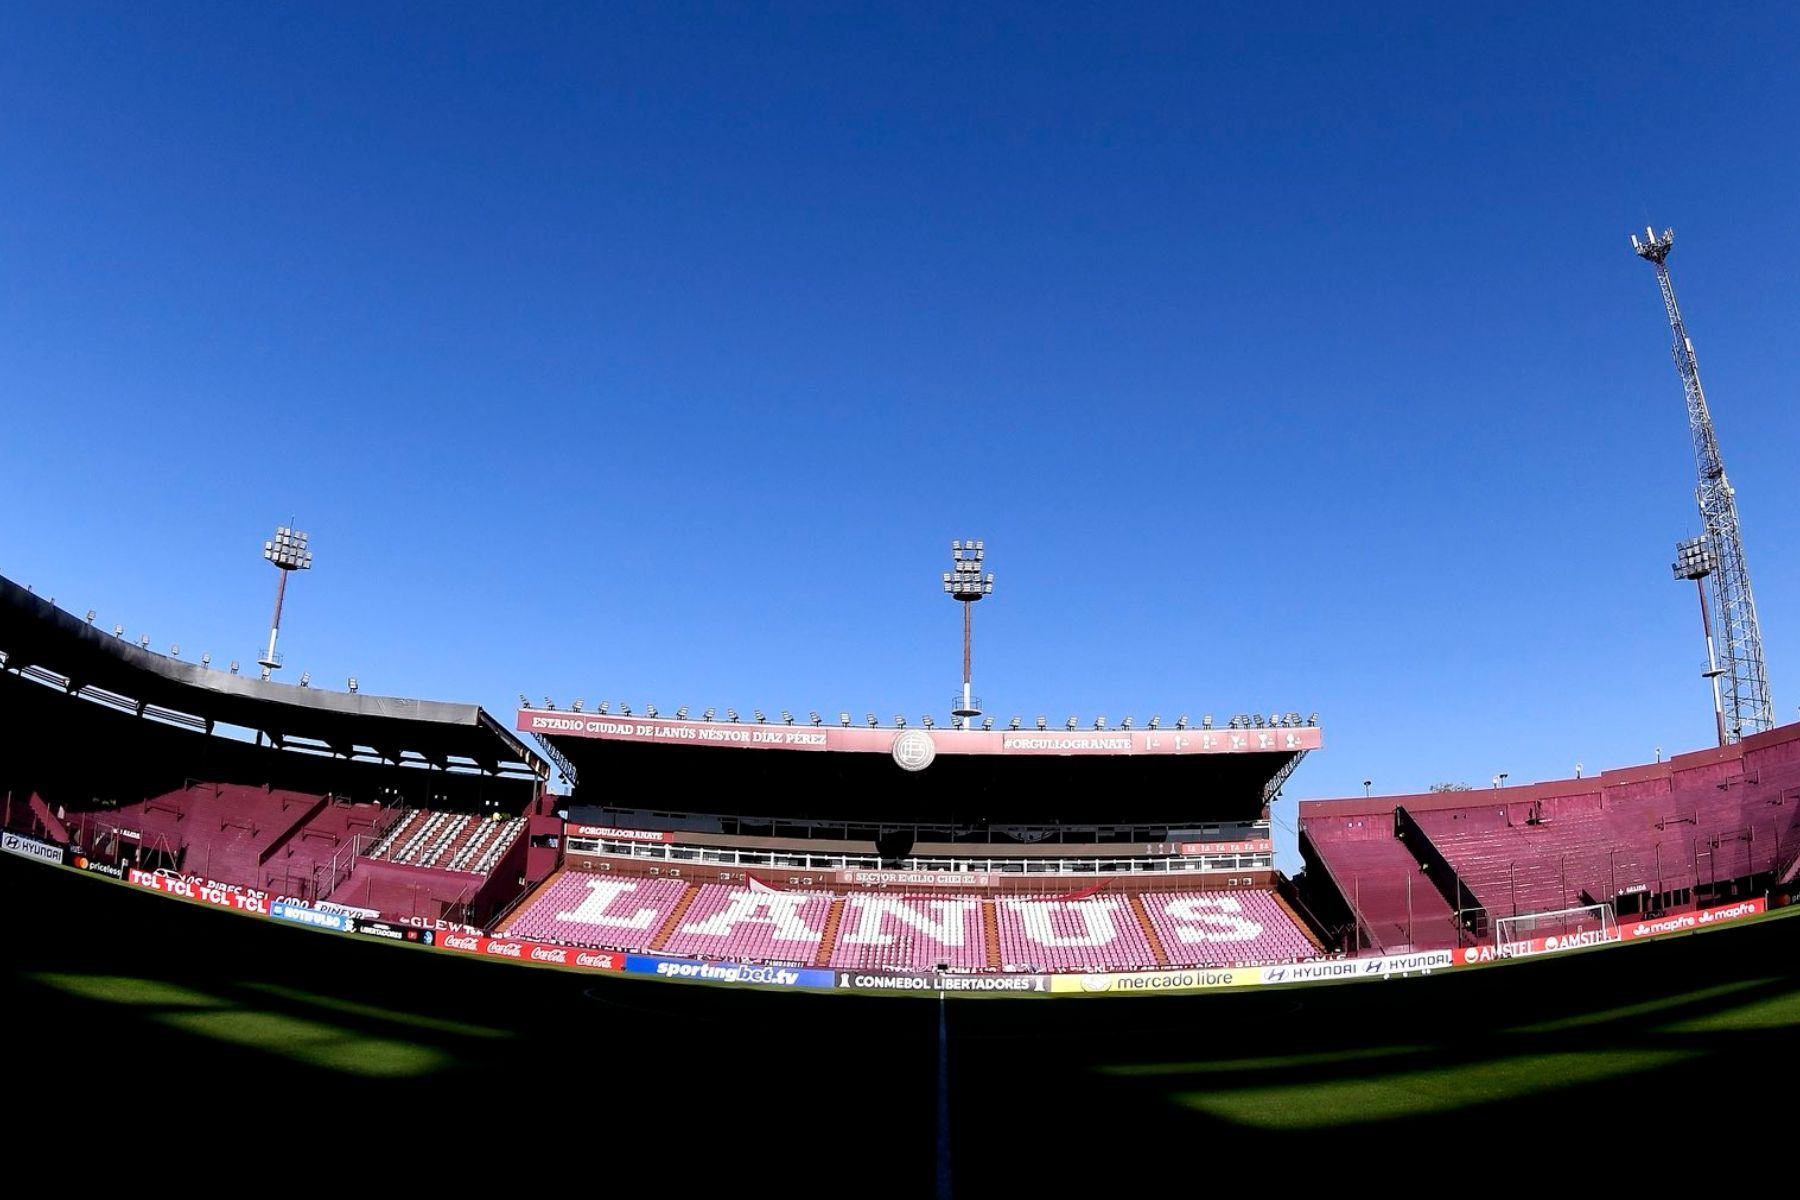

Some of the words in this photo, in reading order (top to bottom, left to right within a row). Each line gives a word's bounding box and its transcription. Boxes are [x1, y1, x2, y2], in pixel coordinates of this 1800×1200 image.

[532, 717, 583, 731] ESTADIO
[586, 721, 633, 735] CIUDAD
[636, 725, 654, 736] DE
[655, 725, 696, 739] LANÚS
[698, 727, 750, 742] NÉSTOR
[752, 730, 783, 743] DÍAZ
[786, 731, 827, 745] PÉREZ
[1004, 738, 1131, 749] #ORGULLOGRANATE
[578, 826, 663, 840] #ORGULLOGRANATE
[22, 842, 61, 861] HYUNDAI
[89, 862, 121, 876] priceless
[856, 873, 896, 882] SECTOR
[132, 870, 161, 889] TCL
[165, 878, 195, 897] TCL
[199, 886, 231, 905] TCL
[235, 895, 267, 913] TCL
[411, 917, 463, 932] GLEW
[1651, 916, 1695, 932] mapfre
[1714, 902, 1755, 920] mapfre
[656, 961, 799, 985] sportingbet.tv
[1293, 964, 1356, 979] HYUNDAI
[1389, 954, 1449, 970] HYUNDAI
[855, 975, 931, 990] CONMEBOL
[934, 977, 1030, 990] LIBERTADORES
[1117, 974, 1193, 989] mercado
[1197, 972, 1233, 986] libre
